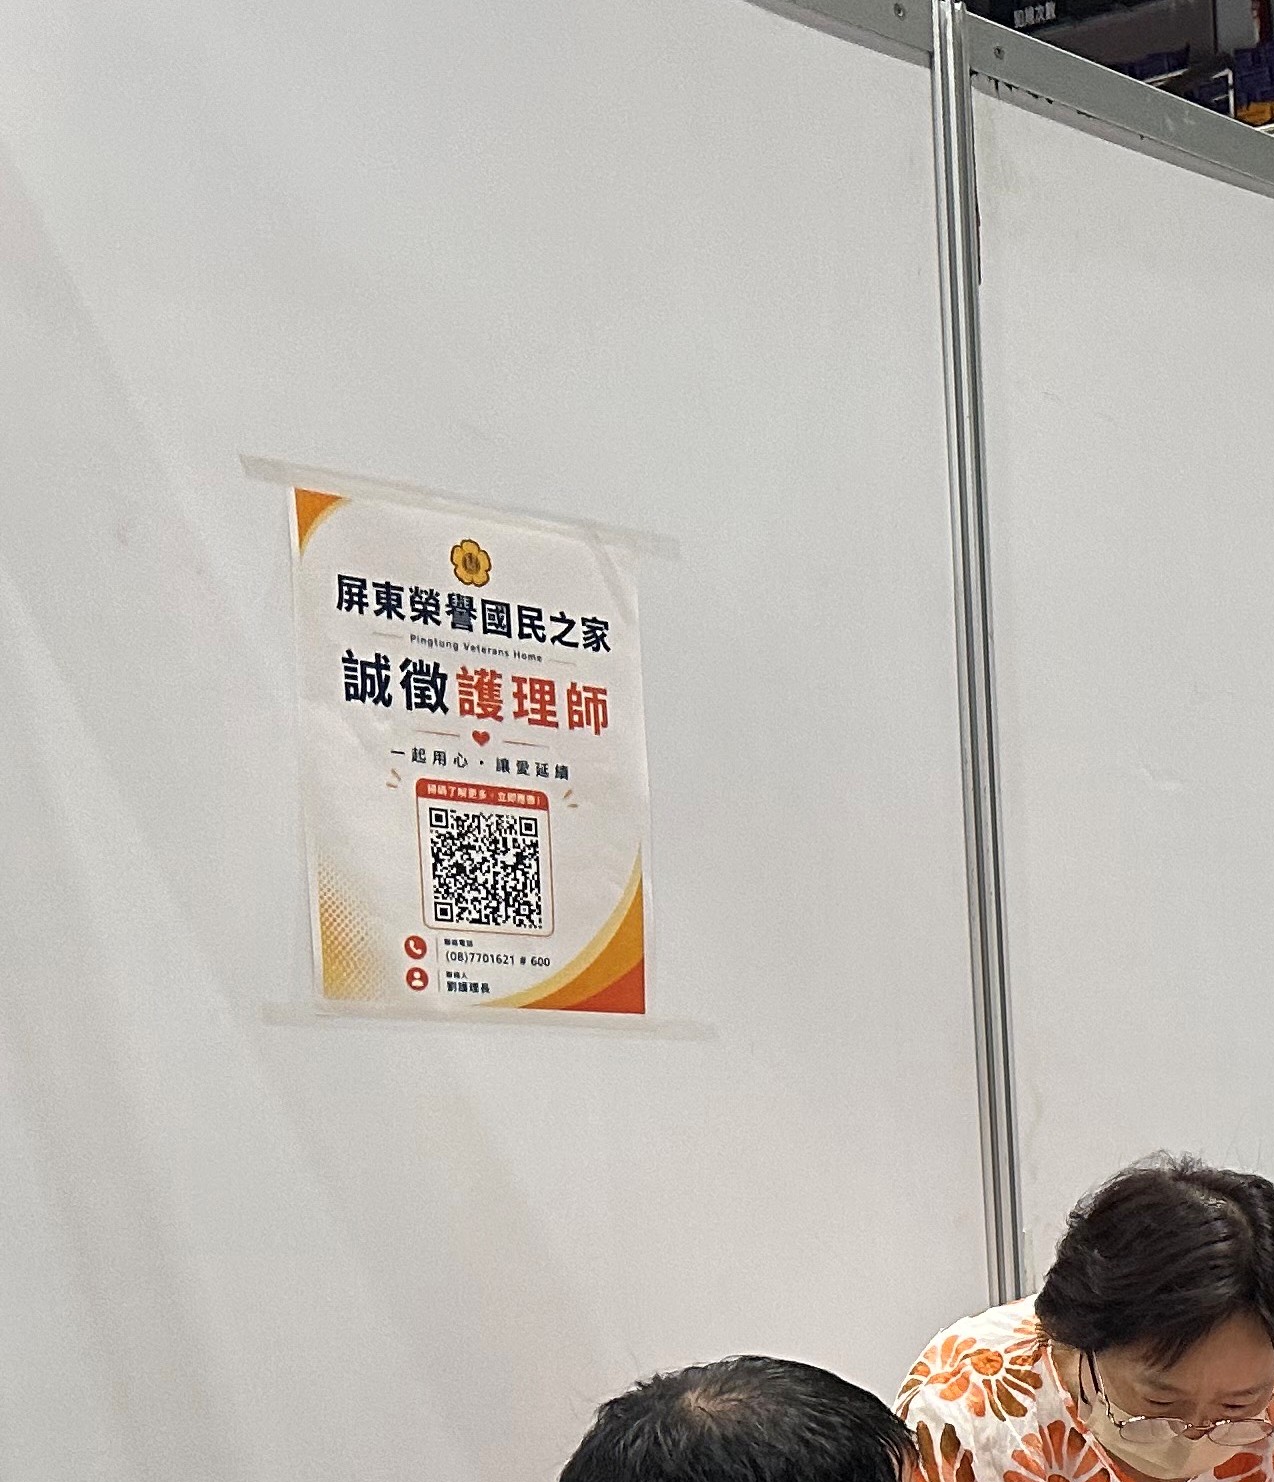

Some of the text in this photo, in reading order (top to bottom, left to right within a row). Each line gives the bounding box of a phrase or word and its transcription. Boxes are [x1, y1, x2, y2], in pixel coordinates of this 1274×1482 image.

[336, 574, 612, 653] 屏東榮譽國民之家
[410, 633, 542, 663] Pingtung Veterans Home
[341, 648, 609, 736] 誠徵護理師
[446, 951, 515, 966] (08)7701621
[531, 956, 551, 967] 600
